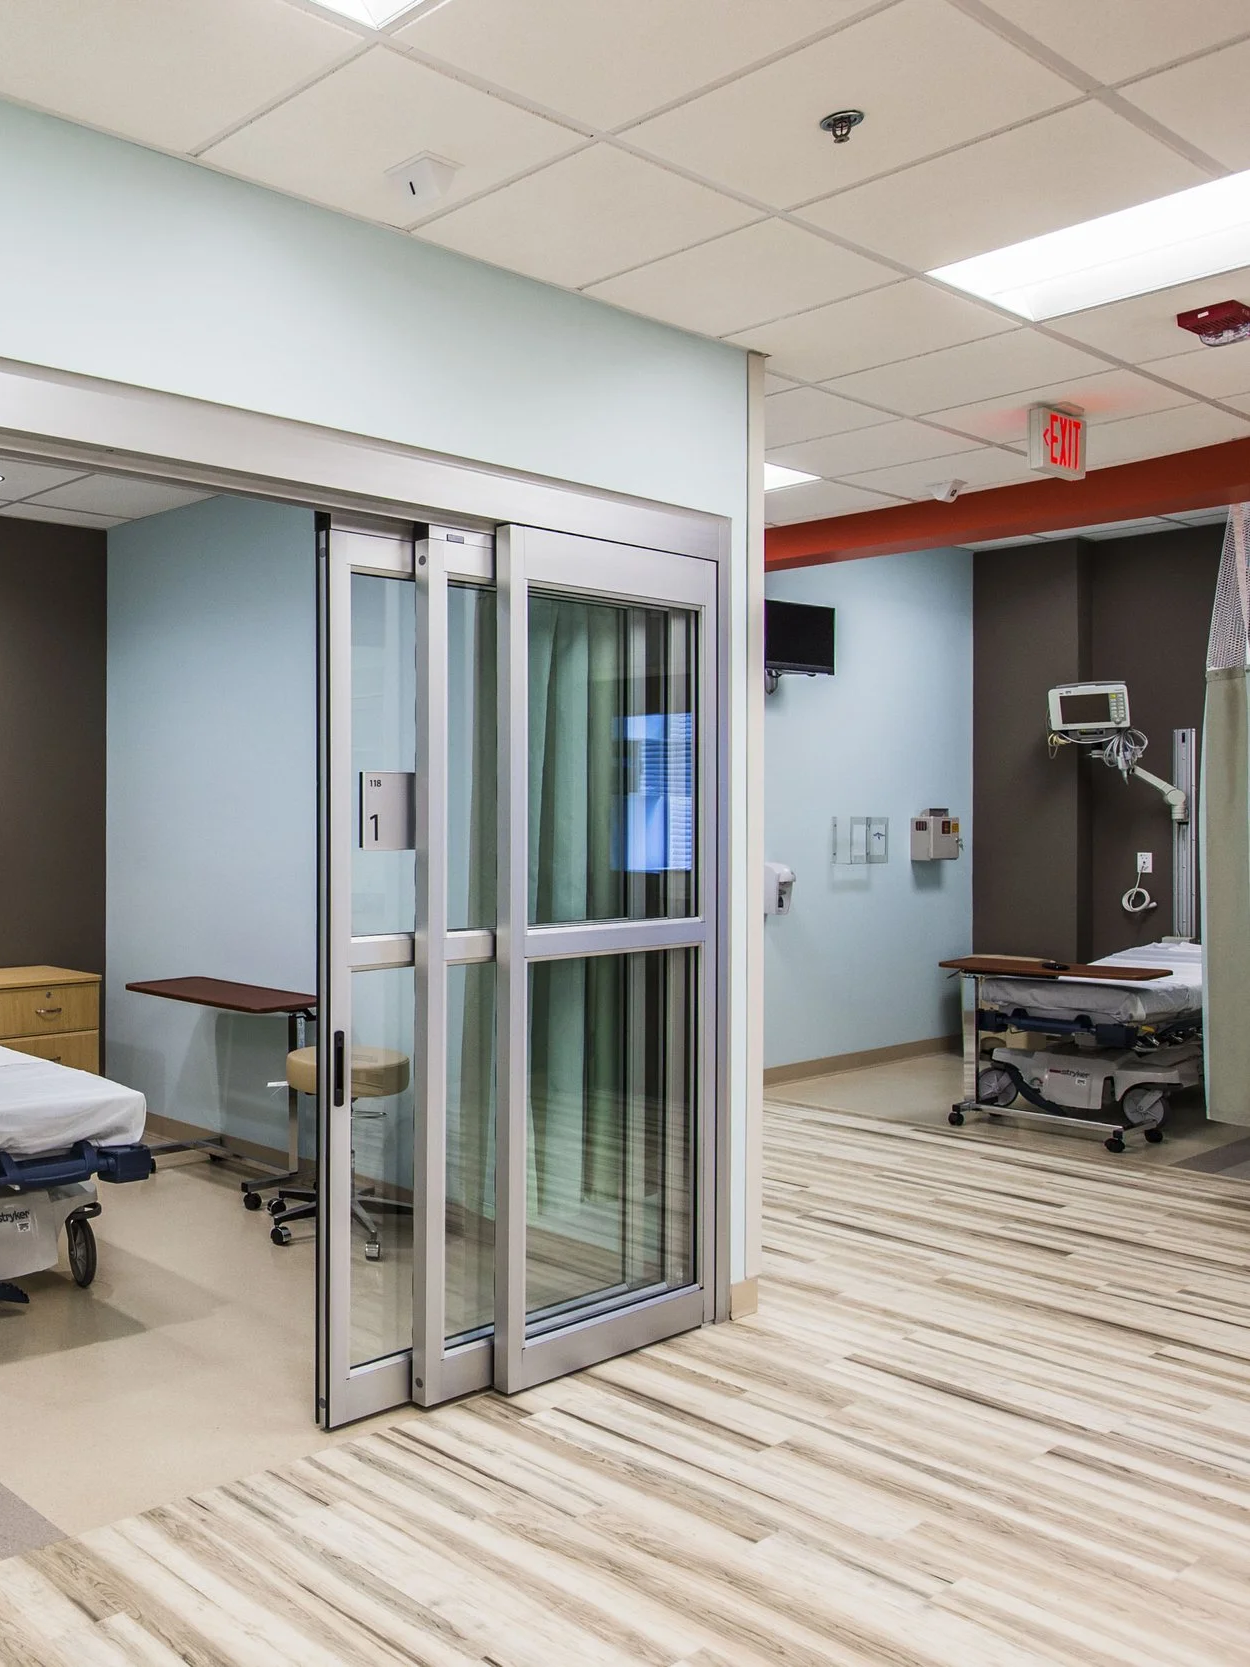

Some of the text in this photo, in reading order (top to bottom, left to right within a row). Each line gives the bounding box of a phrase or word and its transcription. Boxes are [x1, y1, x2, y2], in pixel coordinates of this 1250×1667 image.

[1050, 413, 1082, 470] EXIT
[369, 779, 382, 788] 118
[369, 813, 379, 842] 1
[1060, 1068, 1091, 1079] stryker
